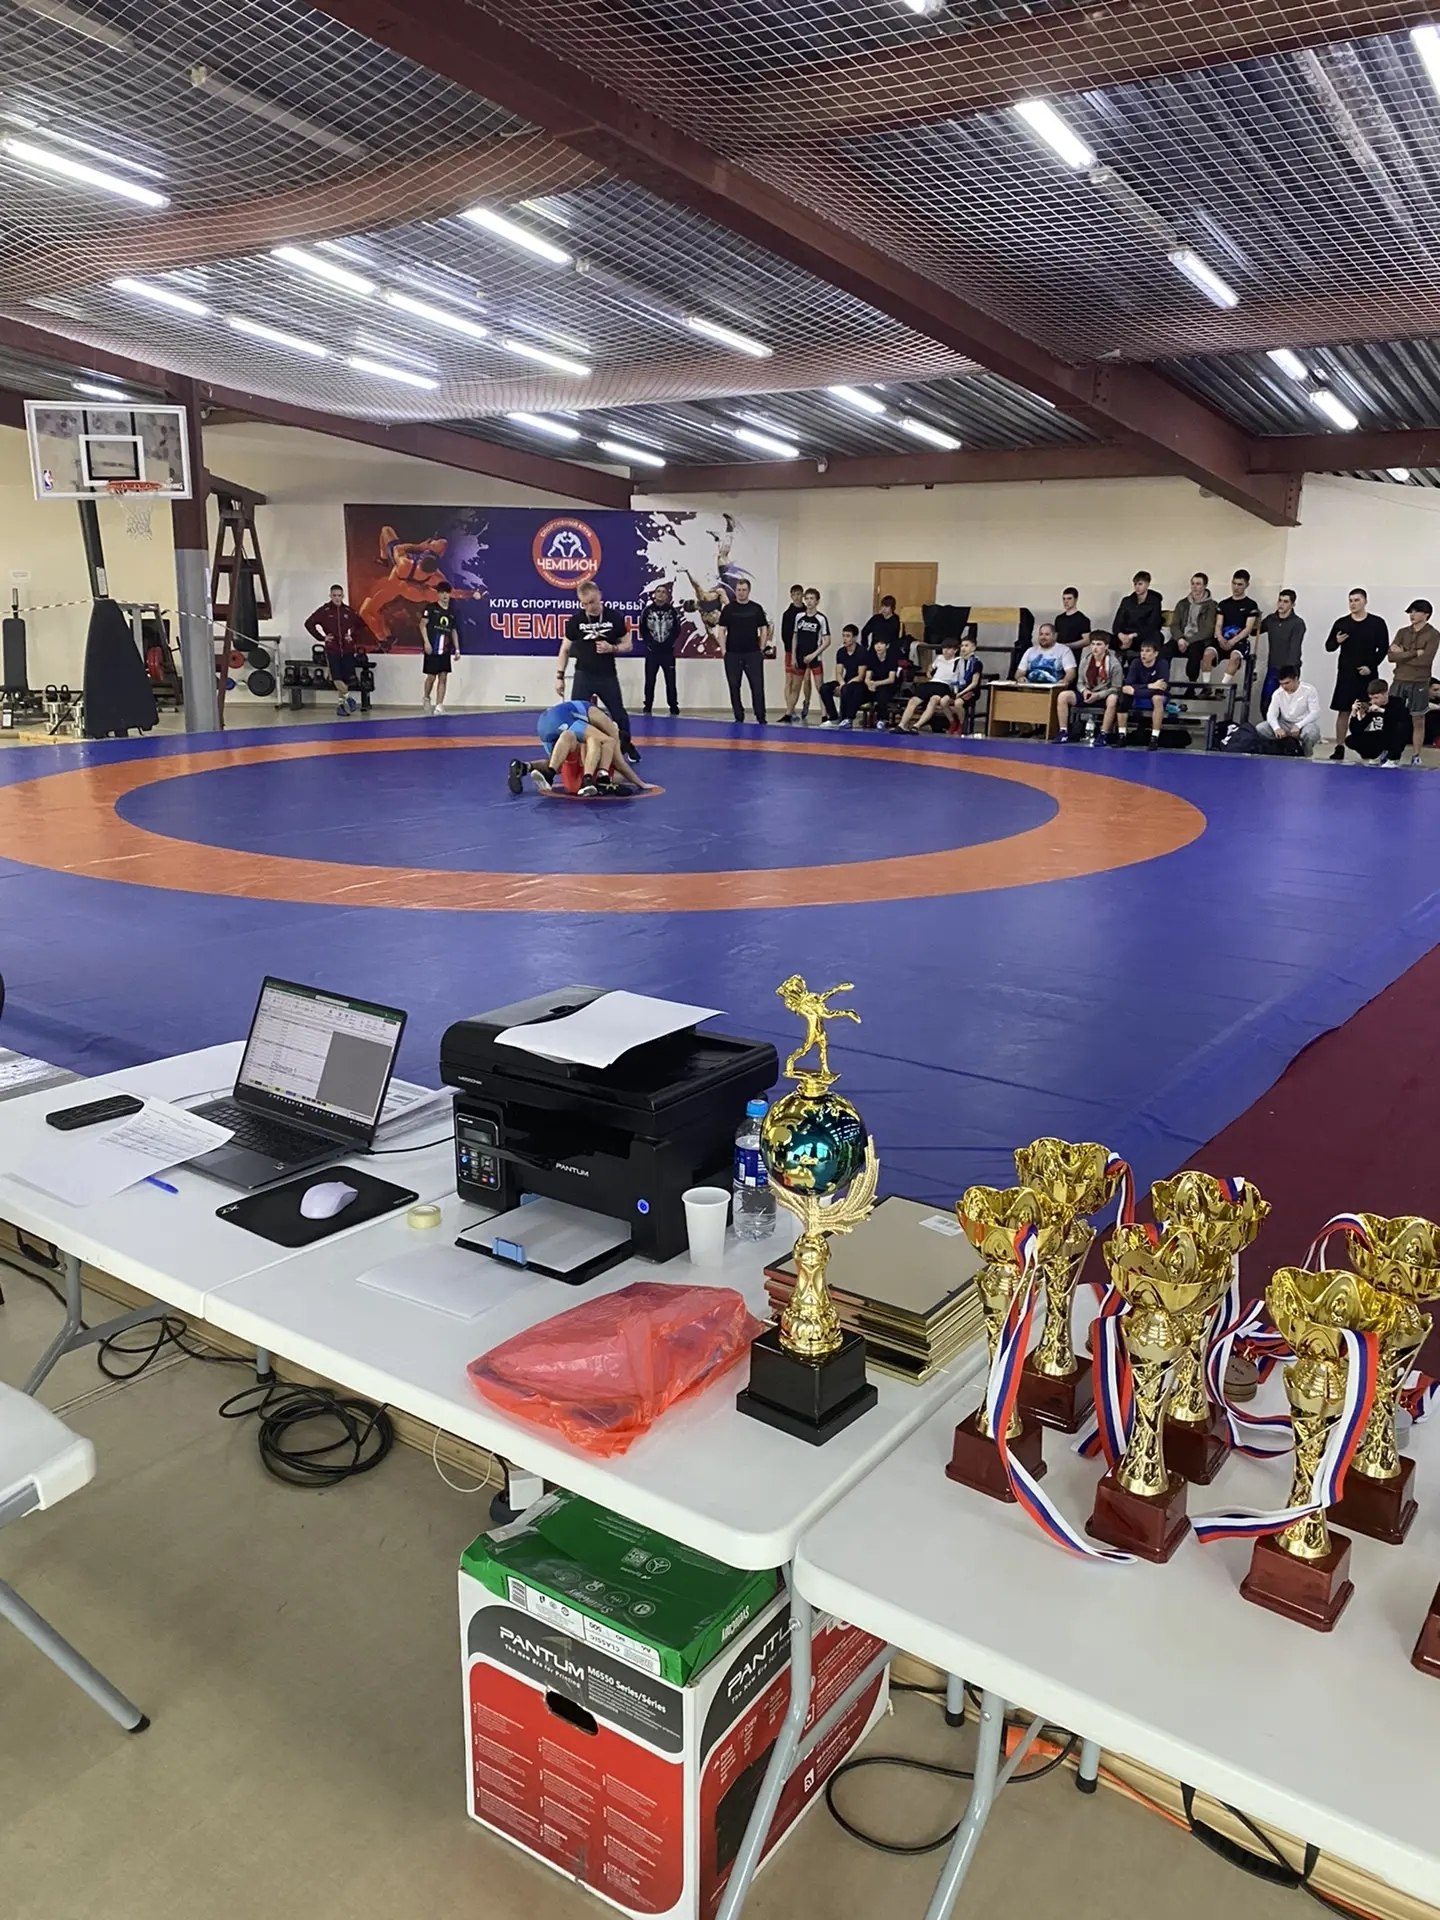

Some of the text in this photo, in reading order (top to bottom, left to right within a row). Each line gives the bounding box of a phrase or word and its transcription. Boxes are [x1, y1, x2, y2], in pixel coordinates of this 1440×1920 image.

[537, 558, 598, 571] ЧЕМПИОН
[489, 598, 518, 608] КЛУБ
[521, 599, 585, 610] СПОРТИВНО
[490, 612, 644, 641] ЧЕМПН
[555, 1162, 589, 1177] PANTUM
[499, 1626, 585, 1680] PANTUM
[727, 1626, 792, 1698] PANTU
[504, 1643, 517, 1654] The
[518, 1651, 531, 1661] New
[555, 1670, 582, 1689] Printing
[587, 1665, 615, 1686] M6550
